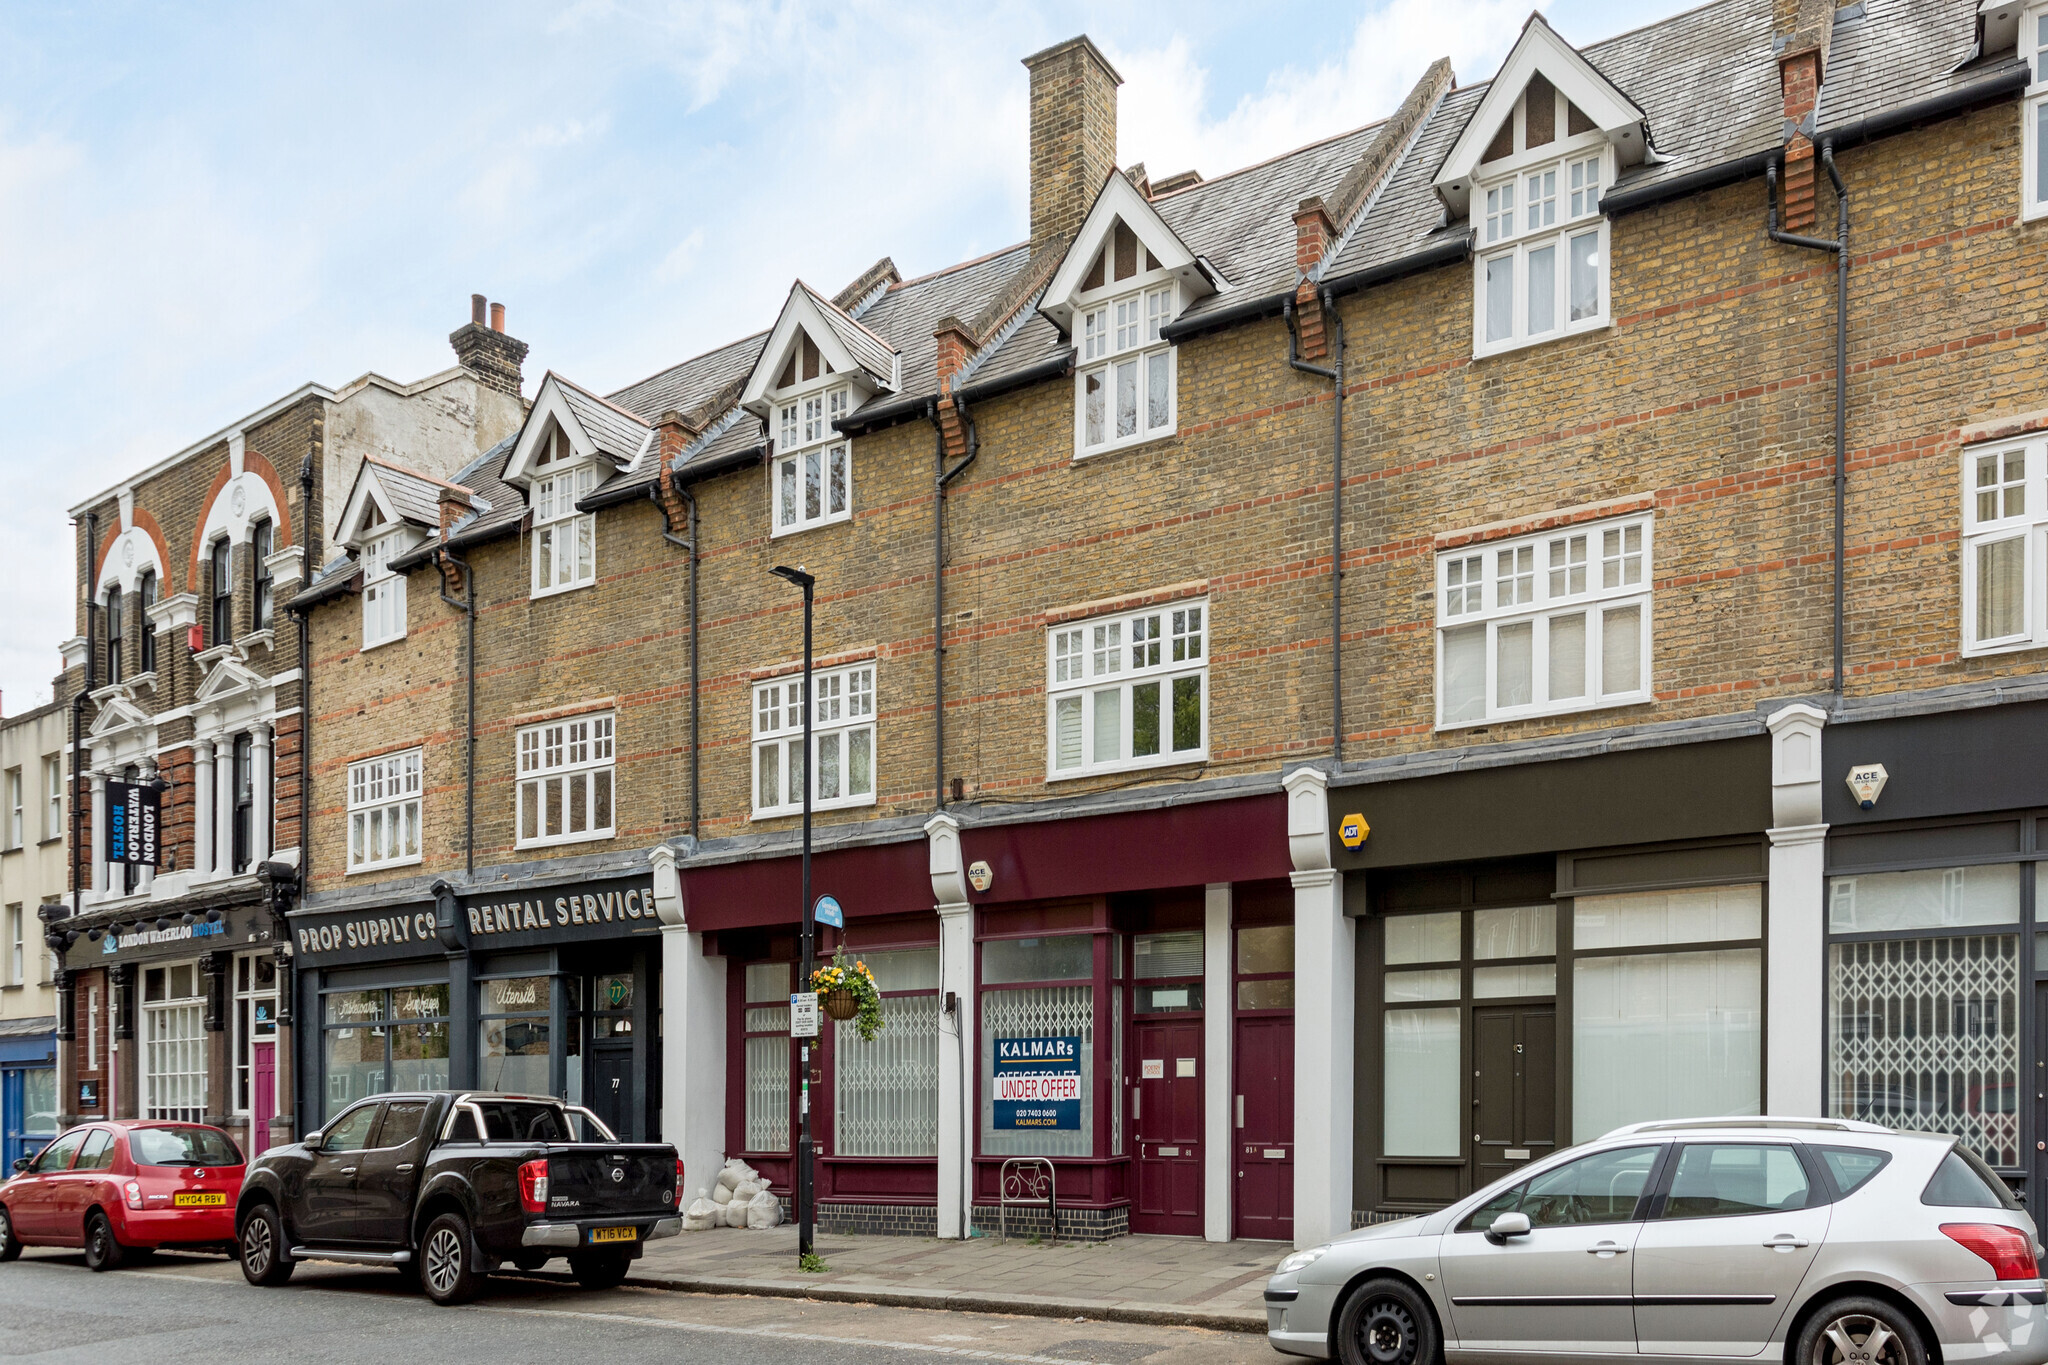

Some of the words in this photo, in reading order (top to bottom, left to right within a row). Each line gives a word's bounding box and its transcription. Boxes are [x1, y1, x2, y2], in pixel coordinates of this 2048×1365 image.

[1855, 771, 1878, 781] ACE
[128, 787, 140, 862] WATERLOO
[1344, 826, 1358, 837] ADT
[112, 804, 125, 860] HOSTEL
[143, 804, 155, 863] LONDON
[969, 868, 986, 876] ACE
[467, 899, 551, 935] RENTAL
[554, 887, 657, 927] SERVICE
[118, 931, 149, 949] LONDON
[149, 925, 192, 944] WATERLOO
[192, 919, 224, 938] HOSTEL
[298, 924, 343, 954] PROP
[345, 915, 410, 949] SUPPLY
[496, 984, 536, 1005] Utensils
[611, 985, 622, 998] 77
[1000, 1040, 1074, 1057] KALMARs
[611, 1078, 620, 1089] 77
[1001, 1079, 1038, 1098] UNDER
[1041, 1078, 1076, 1098] OFFER
[1016, 1109, 1027, 1117] 020
[1027, 1109, 1041, 1117] 7403
[1042, 1109, 1057, 1117] 0600
[1015, 1118, 1057, 1126] KALMARS.COM
[178, 1195, 202, 1204] HY04
[204, 1194, 222, 1204] RBV
[551, 1200, 580, 1208] NAVARA
[595, 1227, 615, 1240] WT16
[617, 1226, 634, 1239] VCX
